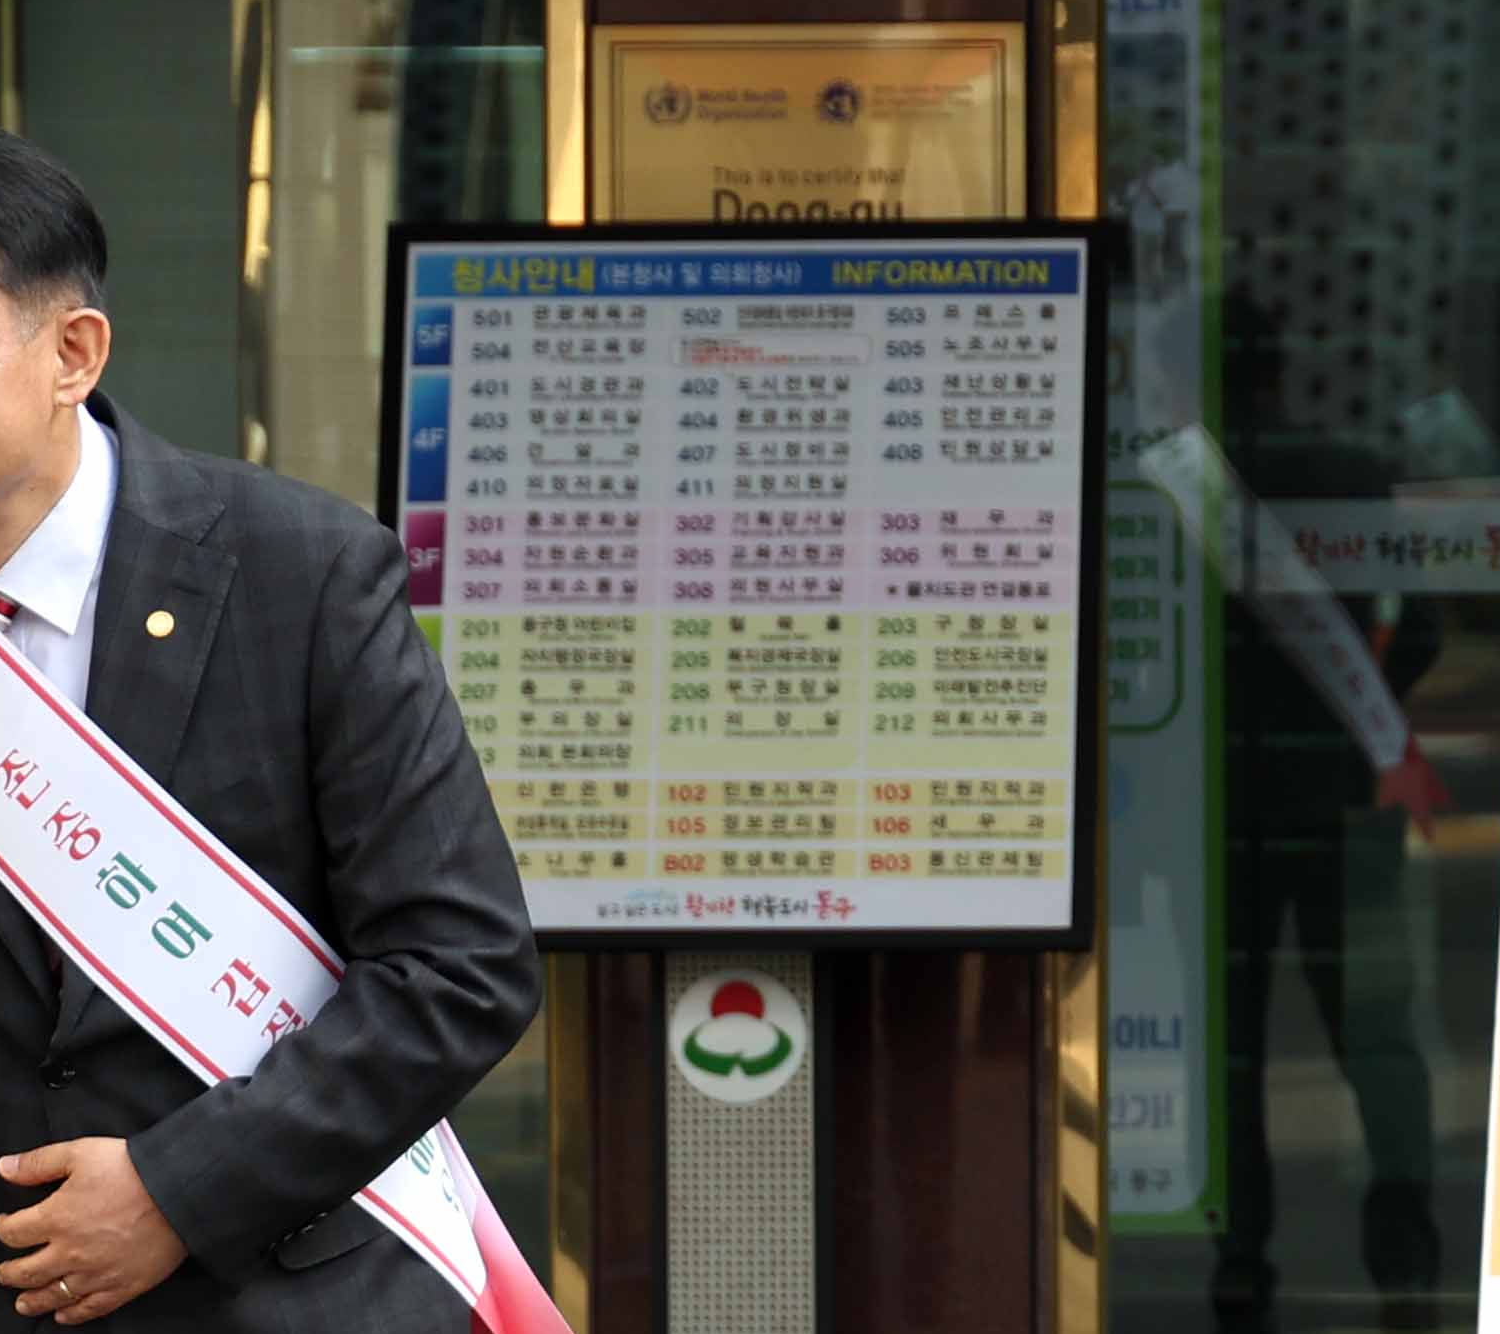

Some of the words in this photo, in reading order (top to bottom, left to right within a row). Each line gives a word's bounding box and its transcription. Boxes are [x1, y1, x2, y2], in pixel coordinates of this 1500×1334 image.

[713, 167, 751, 185] This
[452, 257, 596, 293] 청사안내
[831, 260, 1050, 286] INFORMATION
[473, 309, 511, 326] 501
[682, 308, 721, 325] 502
[887, 307, 925, 324] 503
[471, 343, 510, 360] 504
[886, 340, 924, 357] 505
[471, 379, 509, 396] 401
[680, 378, 718, 395] 402
[885, 377, 923, 394] 403
[679, 412, 717, 430] 404
[413, 427, 447, 450] 4F
[678, 445, 716, 462] 407
[467, 479, 506, 496] 410
[677, 479, 714, 496] 411
[466, 515, 504, 533] 301
[675, 515, 714, 532] 302
[881, 514, 920, 532] 303
[409, 547, 440, 570] 3F
[464, 549, 503, 566] 304
[674, 548, 713, 565] 305
[463, 582, 502, 599] 307
[461, 619, 501, 636] 201
[672, 618, 711, 636] 202
[878, 617, 917, 635] 203
[460, 652, 500, 669] 204
[459, 683, 498, 700] 207
[668, 715, 708, 733] 211
[874, 714, 915, 732] 212
[667, 785, 707, 802] 102
[873, 785, 912, 802] 103
[666, 817, 706, 834] 105
